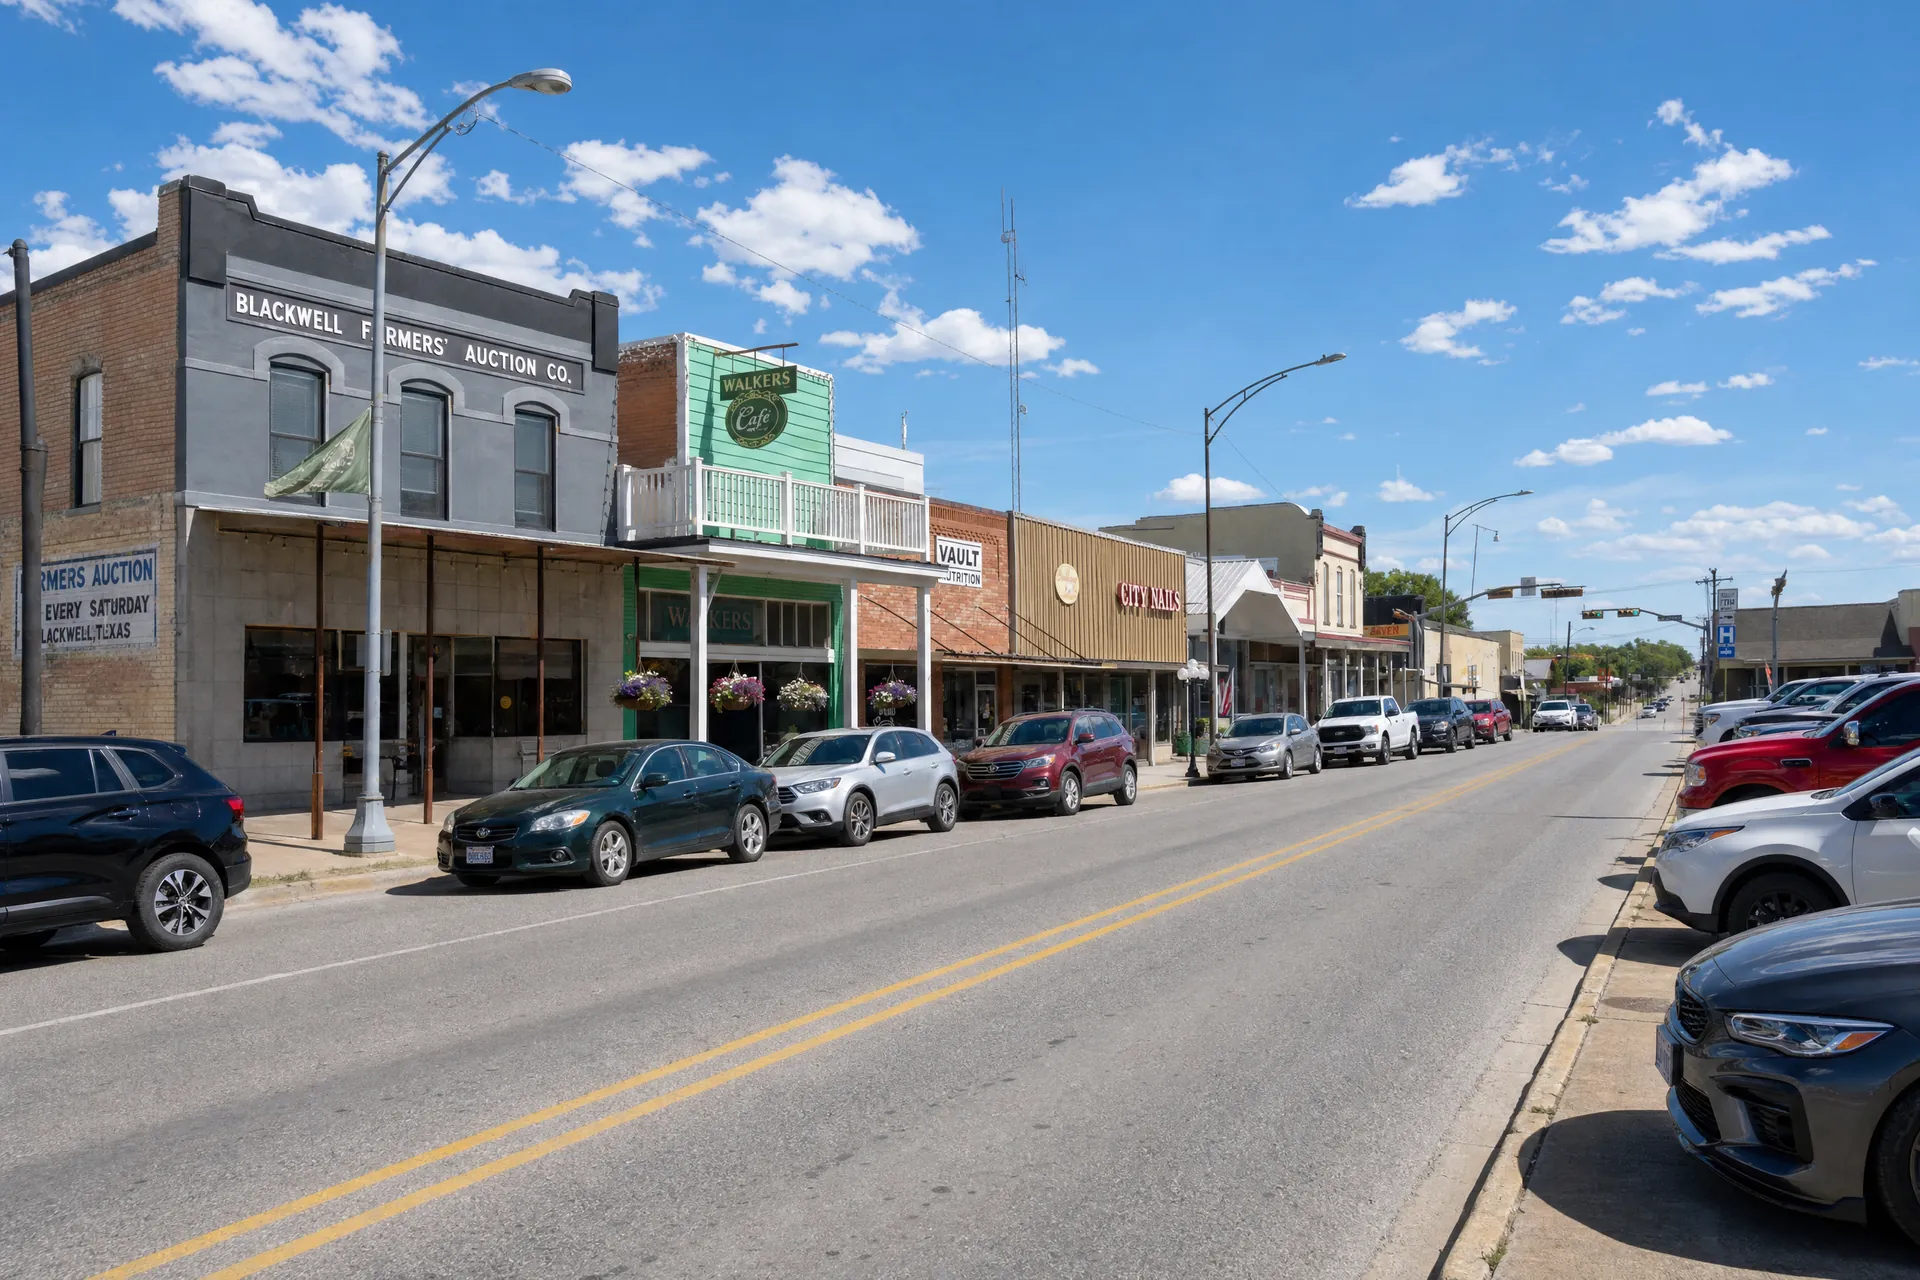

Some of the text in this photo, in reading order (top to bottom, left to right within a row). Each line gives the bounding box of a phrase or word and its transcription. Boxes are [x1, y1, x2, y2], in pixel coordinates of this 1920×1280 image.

[236, 292, 572, 384] BLACKWELL FRMERS' AUCTION CO.
[723, 370, 791, 393] WALKERS
[939, 544, 980, 567] VAULT
[41, 558, 153, 592] RMERS AUCTION
[942, 571, 980, 585] UTRITION
[45, 595, 150, 621] EVERY SATURDAY
[1121, 581, 1181, 612] CITY NAILS
[667, 605, 751, 631] WKERS
[41, 624, 96, 644] LACKWELL,
[1719, 626, 1734, 643] H
